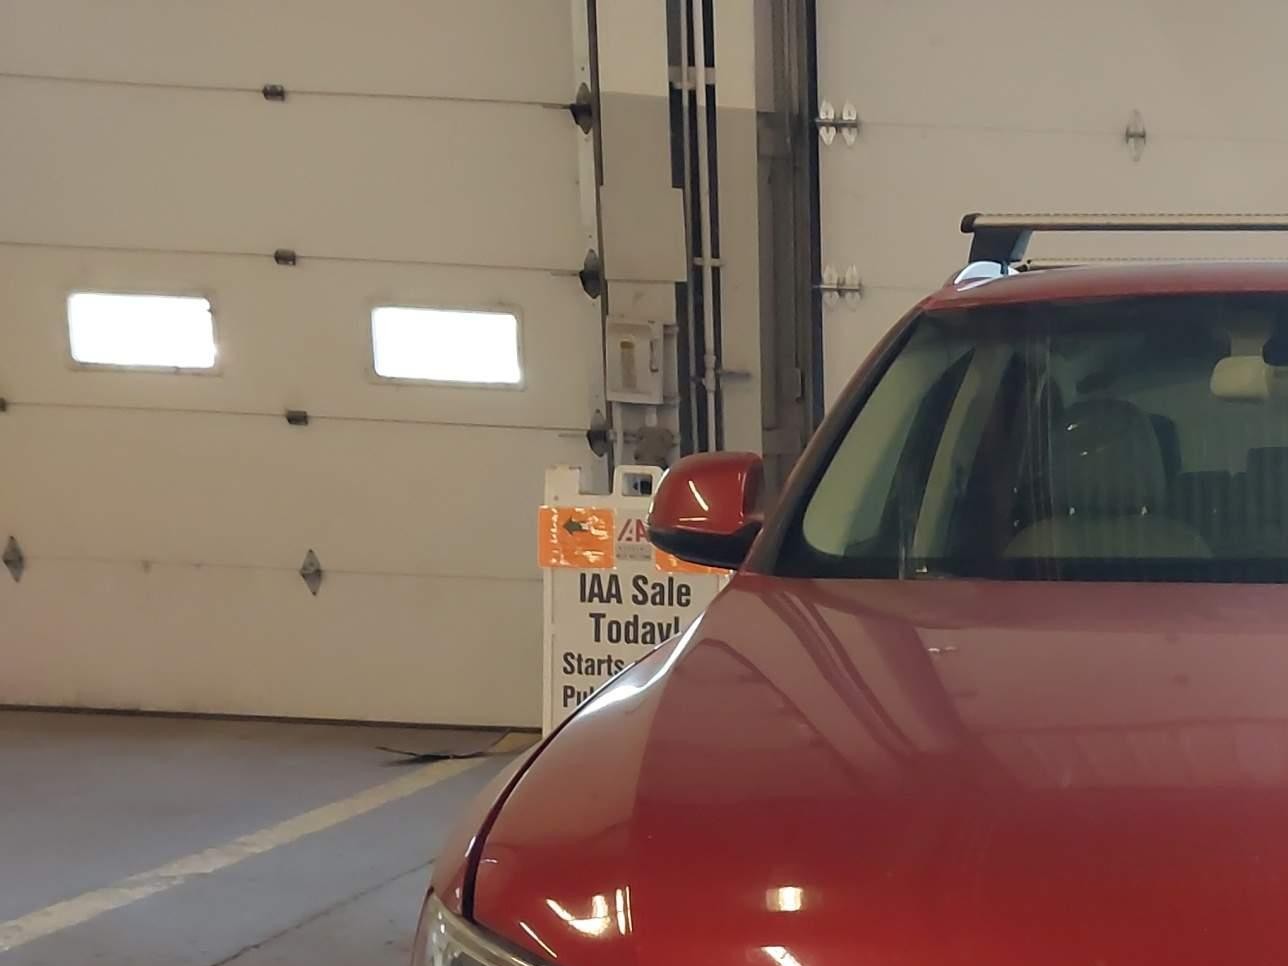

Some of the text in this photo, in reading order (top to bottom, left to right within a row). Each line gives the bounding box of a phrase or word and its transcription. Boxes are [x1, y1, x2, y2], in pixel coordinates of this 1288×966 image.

[579, 572, 691, 607] IAA Sale
[562, 651, 625, 676] Starts
